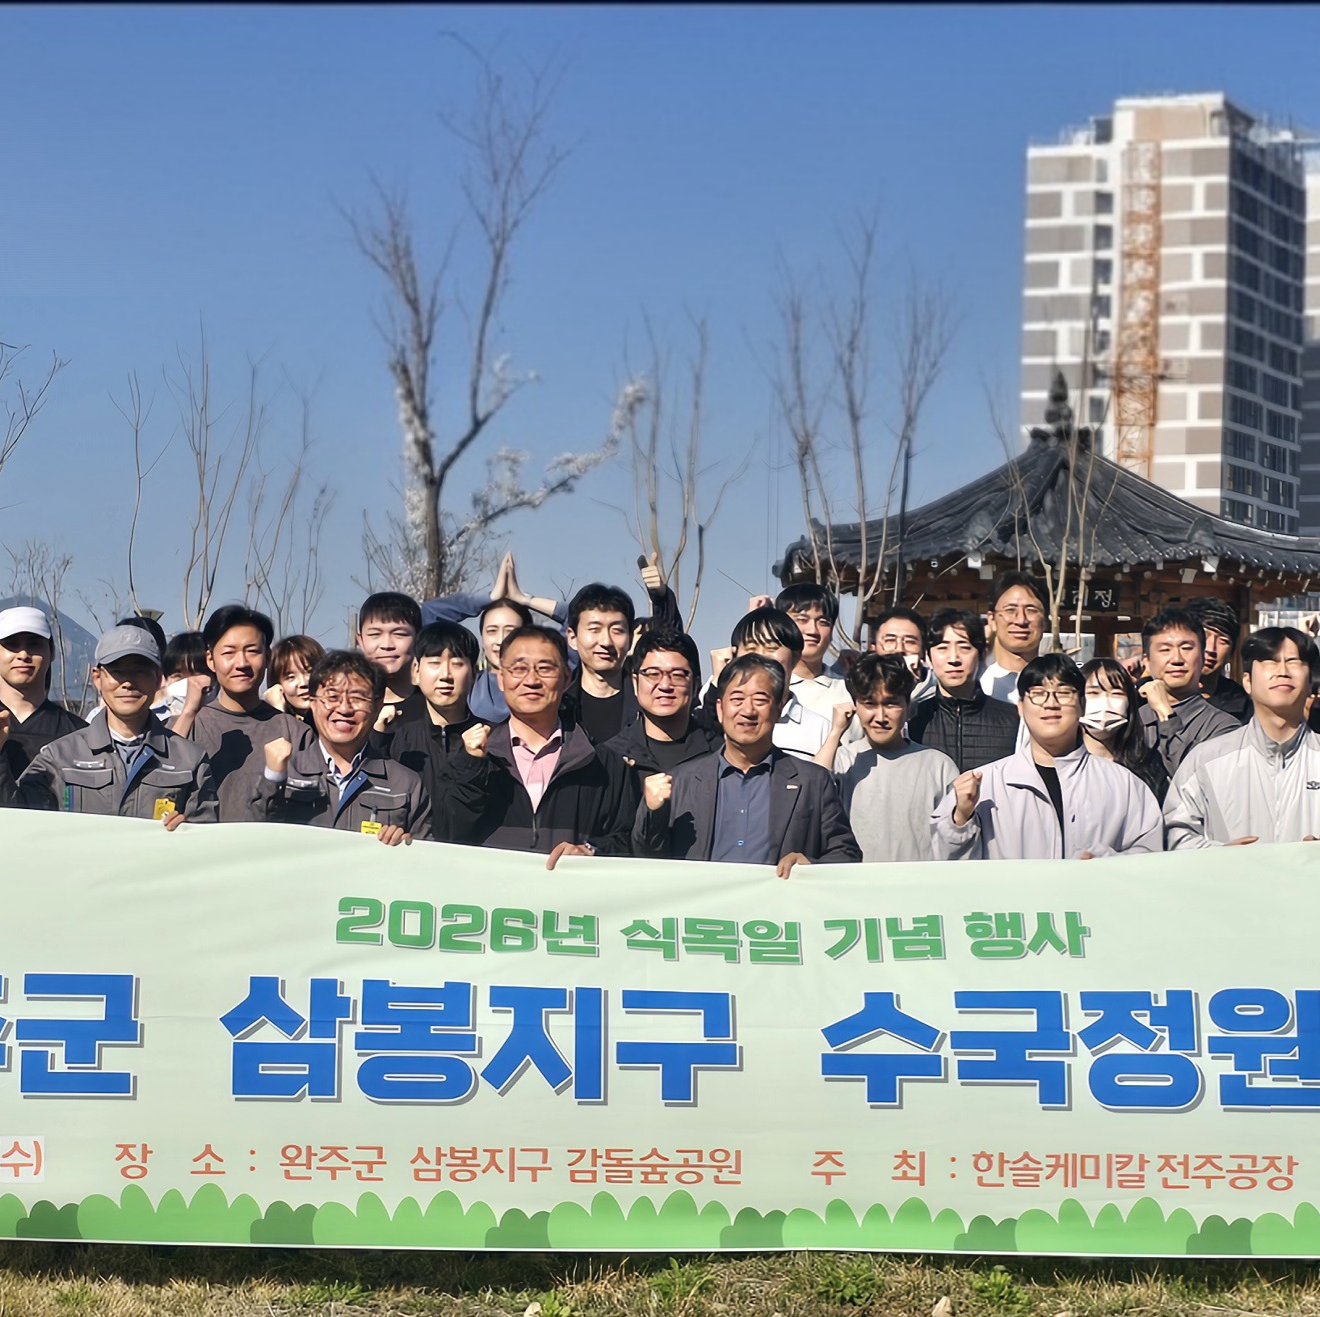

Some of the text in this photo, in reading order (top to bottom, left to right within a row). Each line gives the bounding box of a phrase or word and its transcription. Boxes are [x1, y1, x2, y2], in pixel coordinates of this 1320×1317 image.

[335, 896, 1089, 965] 2026년 식목일 기념 행사
[218, 975, 743, 1107] 삼봉지구
[115, 1143, 153, 1179] 장
[190, 1143, 226, 1176] 소
[279, 1144, 387, 1182] 완주군
[409, 1146, 552, 1183] 삼봉지구
[567, 1148, 742, 1185] 감돌숲공원
[811, 1150, 847, 1185] 주
[891, 1150, 926, 1187] 최
[972, 1151, 1151, 1188] 한솔케미칼
[1156, 1154, 1299, 1191] 전주공장
